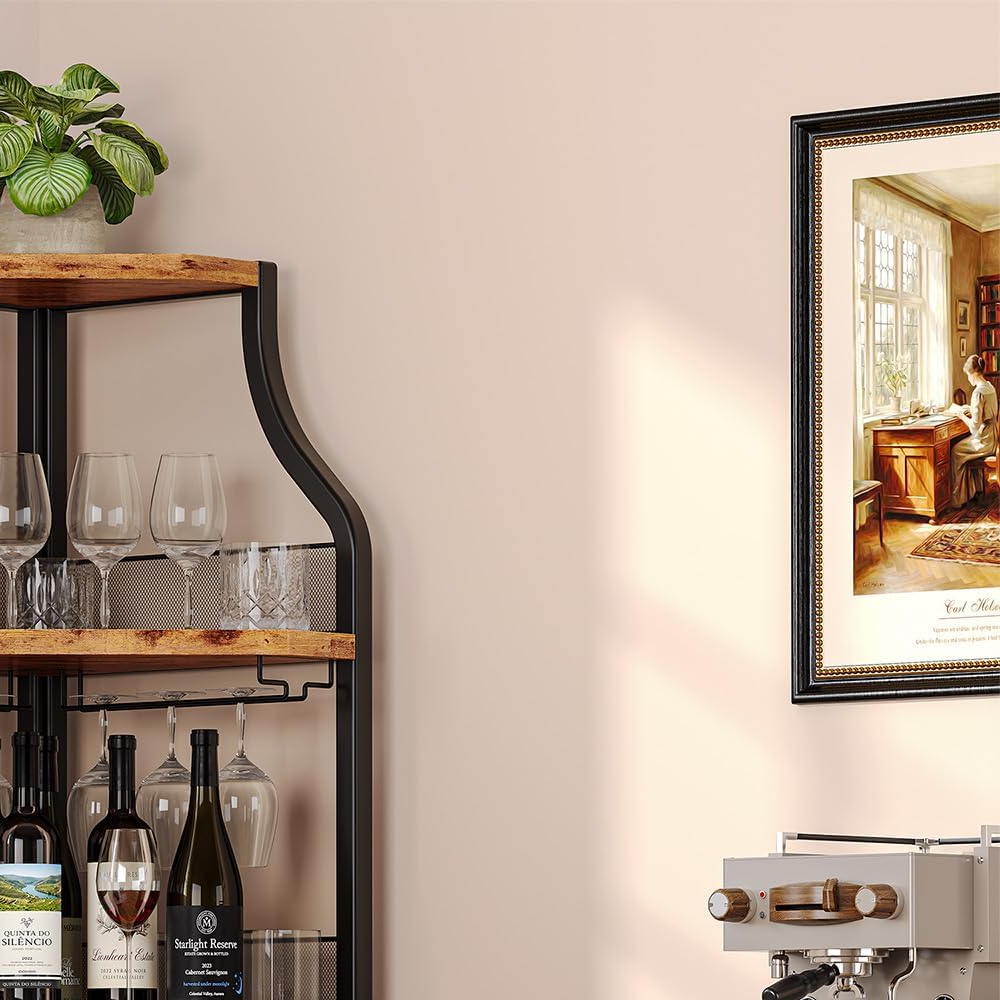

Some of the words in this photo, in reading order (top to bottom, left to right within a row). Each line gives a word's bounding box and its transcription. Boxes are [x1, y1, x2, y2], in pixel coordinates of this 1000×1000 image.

[944, 599, 967, 614] Carl
[3, 930, 37, 938] QUINTA
[1, 936, 53, 946] SILÊNCIO
[174, 938, 208, 951] Starlight
[210, 938, 238, 949] Reserve
[205, 969, 228, 977] Sauvignon
